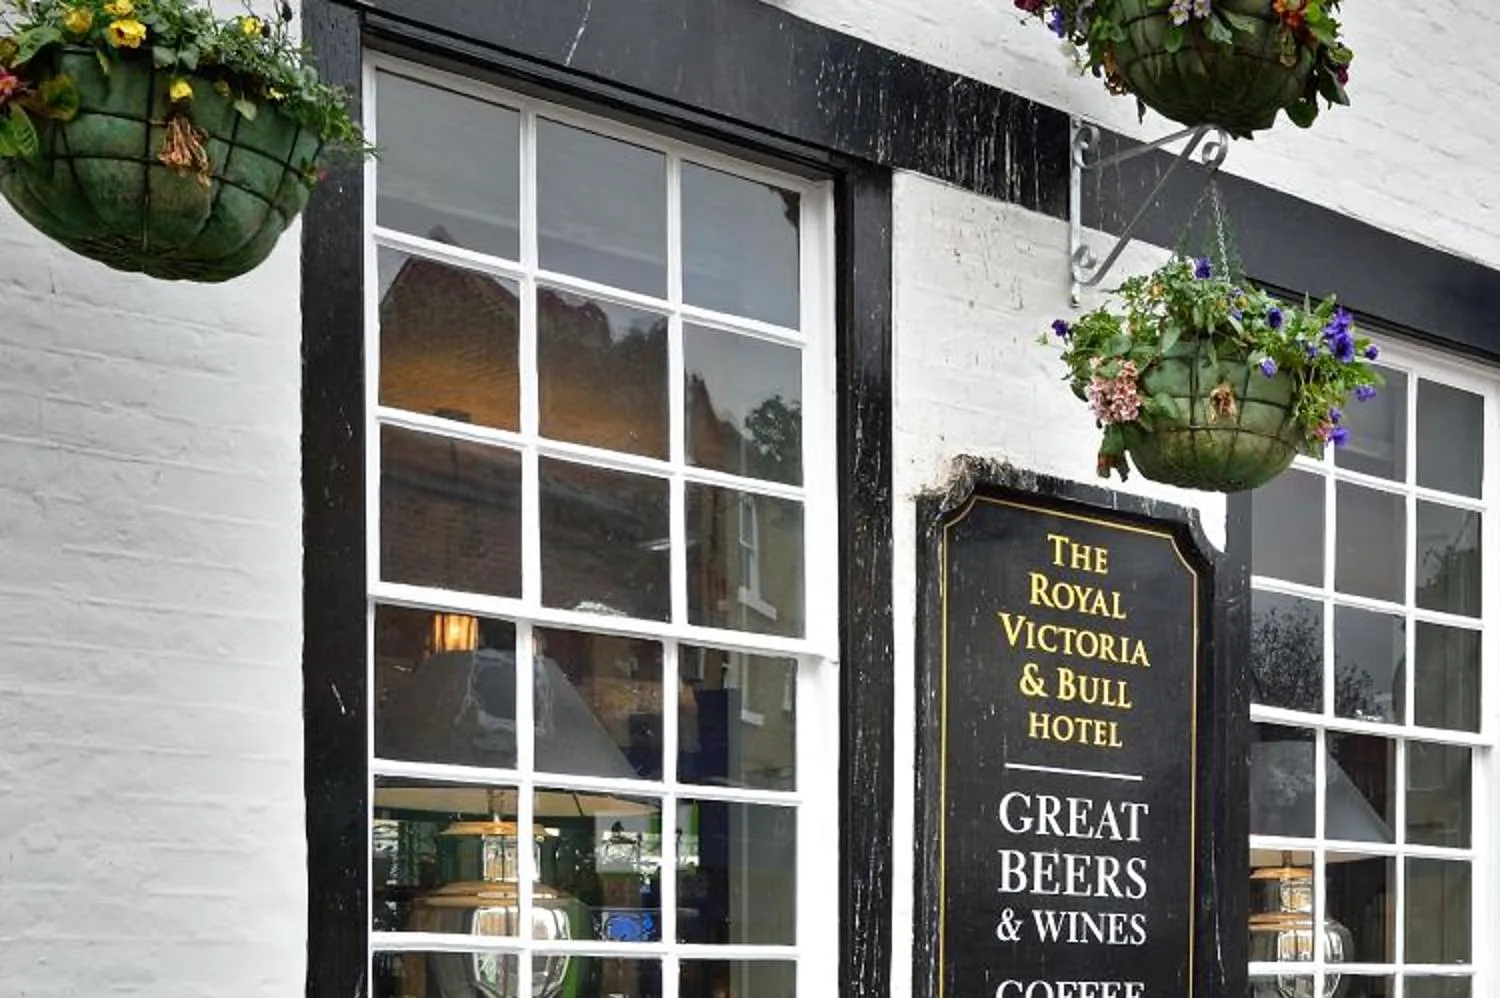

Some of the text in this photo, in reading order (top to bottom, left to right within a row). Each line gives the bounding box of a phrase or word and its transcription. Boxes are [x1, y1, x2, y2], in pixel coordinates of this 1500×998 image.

[1047, 533, 1109, 575] THE
[1028, 571, 1127, 620] ROYAL
[998, 611, 1150, 667] VICTORIA
[1019, 662, 1132, 709] & BULL
[1028, 711, 1123, 748] HOTEL
[998, 790, 1149, 841] GREAT
[997, 849, 1147, 899] BEERS
[996, 907, 1147, 945] & WINES
